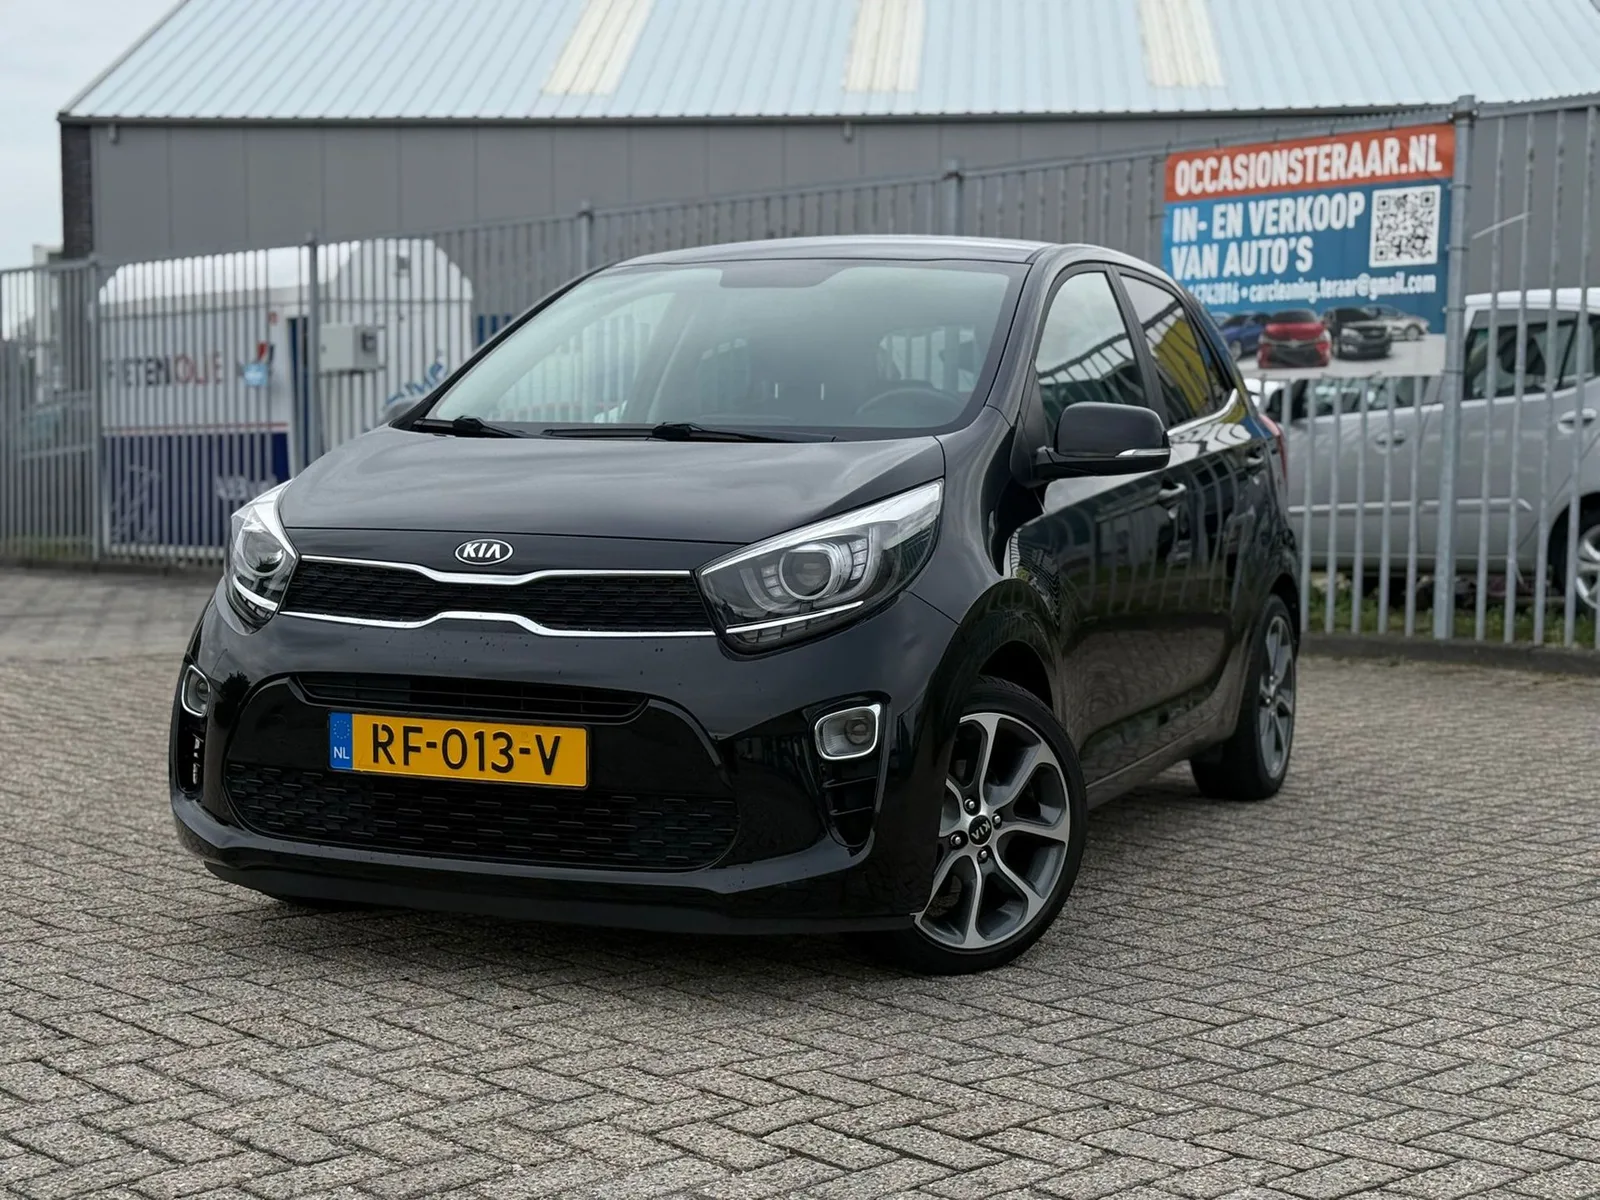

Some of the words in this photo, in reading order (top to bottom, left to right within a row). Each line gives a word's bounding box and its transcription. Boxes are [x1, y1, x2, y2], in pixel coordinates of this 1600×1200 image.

[1175, 134, 1442, 195] OCCASIONSTERAAR.NL
[1172, 205, 1208, 243] IN-
[1212, 202, 1244, 240] EN
[1249, 191, 1366, 236] VERKOOP
[1170, 243, 1220, 281] VAN
[1222, 235, 1314, 278] AUTO'S
[462, 542, 501, 559] KIA
[333, 746, 350, 760] NL
[371, 723, 562, 776] RF-013-V
[971, 820, 991, 840] KIA
